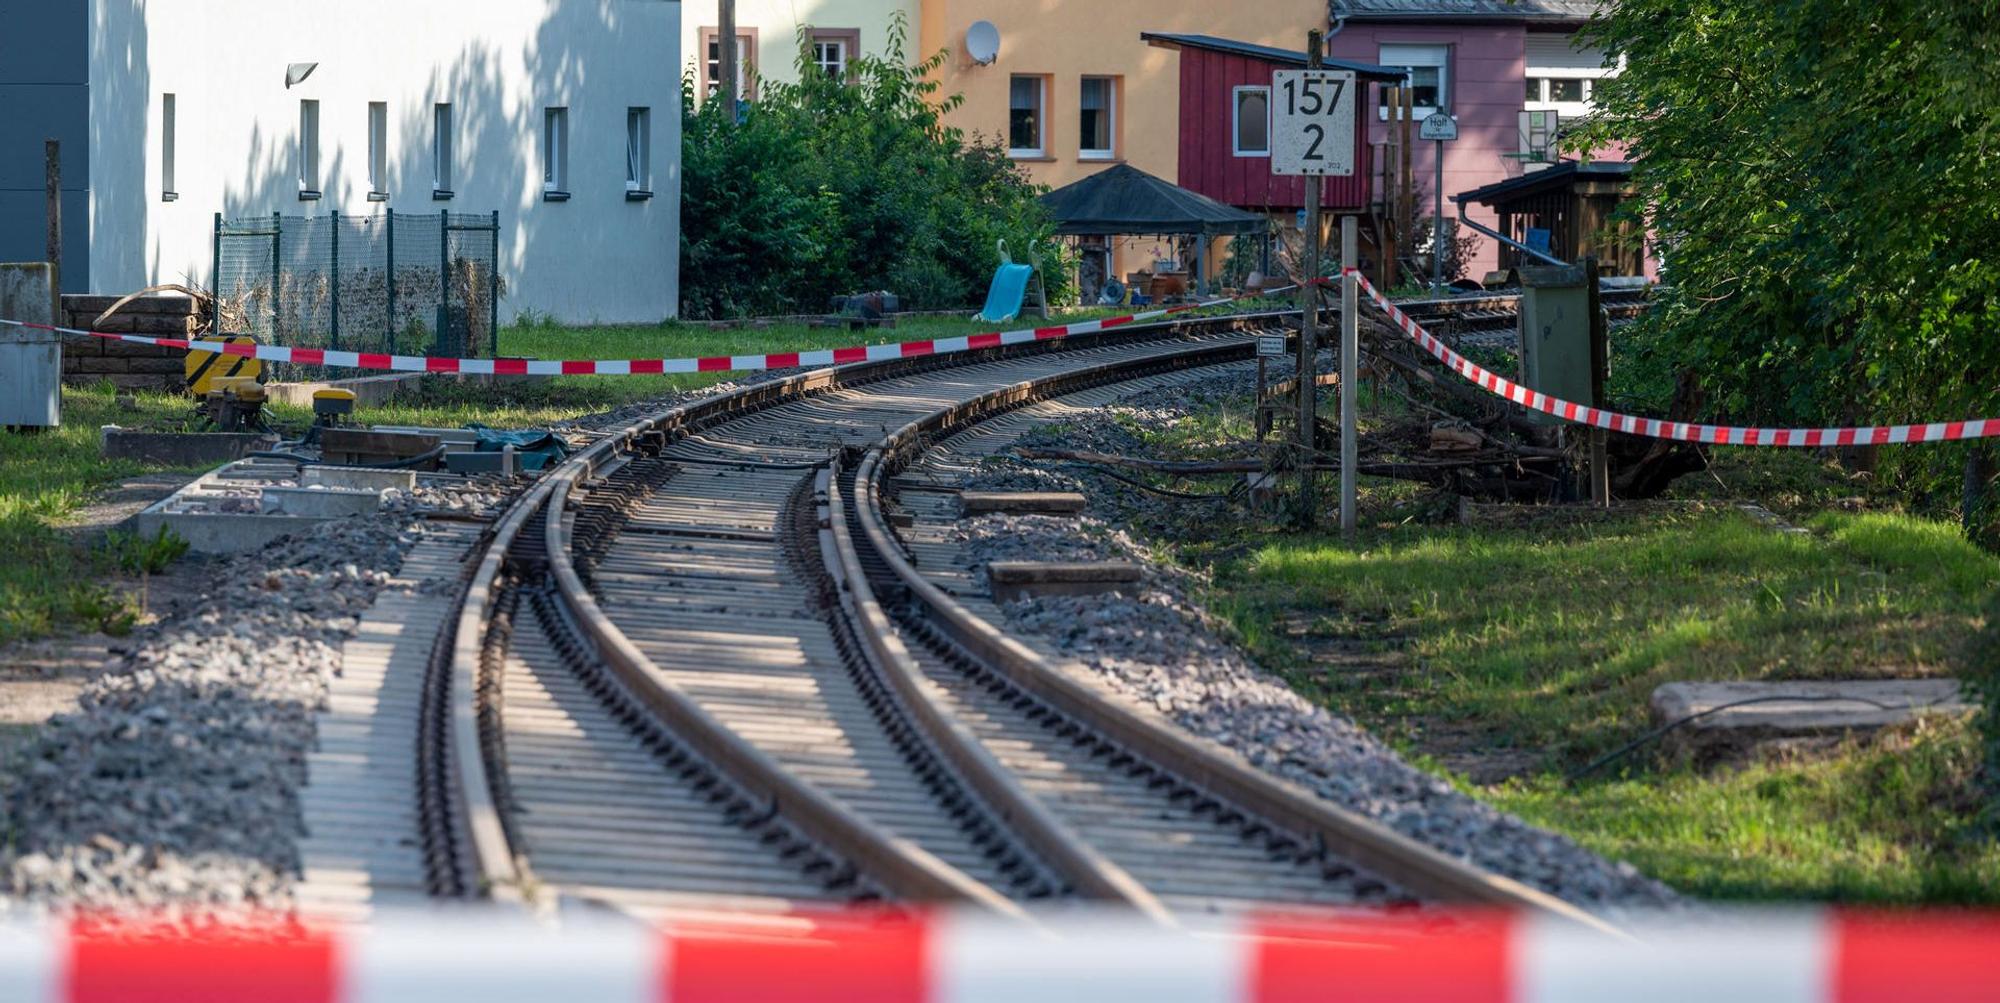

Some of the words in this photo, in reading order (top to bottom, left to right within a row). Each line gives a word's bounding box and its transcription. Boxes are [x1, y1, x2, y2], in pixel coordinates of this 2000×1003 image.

[1283, 79, 1346, 116] 157
[1430, 117, 1448, 127] Halt
[1302, 123, 1324, 160] 2
